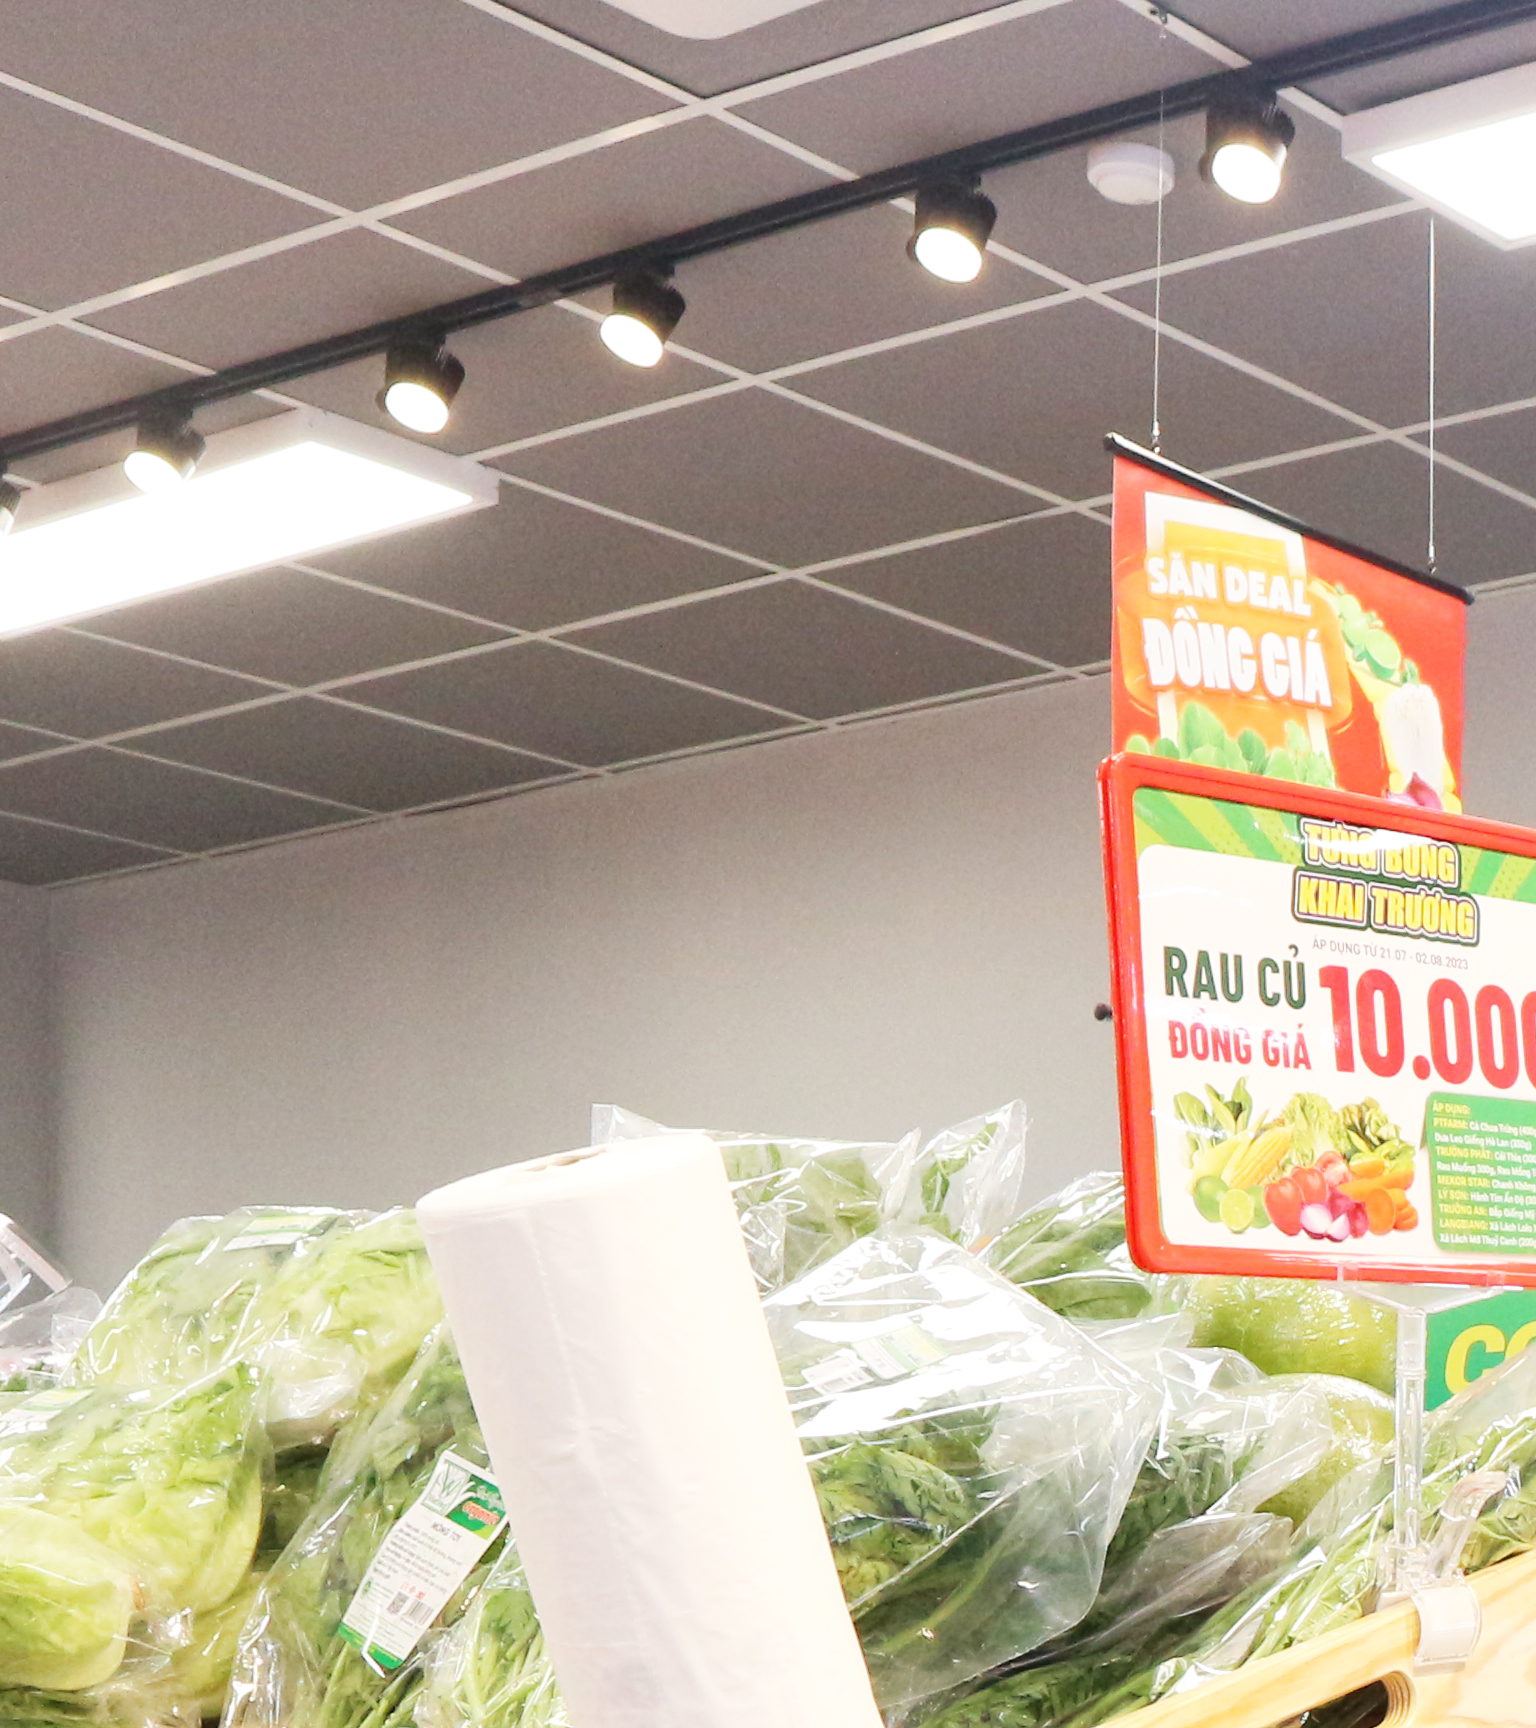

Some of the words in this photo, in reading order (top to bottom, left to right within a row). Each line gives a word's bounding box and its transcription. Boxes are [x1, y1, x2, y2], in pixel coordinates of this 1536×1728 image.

[1148, 548, 1215, 600] SĂN
[1222, 565, 1312, 619] DEAL
[1143, 606, 1258, 692] ĐỒNG
[1262, 627, 1335, 709] GIÁ
[1298, 874, 1366, 922] KHAI
[1370, 886, 1476, 940] TRƯƠNG
[1163, 945, 1245, 1002] RAU
[1257, 942, 1307, 1011] CỦ
[1312, 934, 1327, 949] ÁP
[1330, 940, 1361, 957] DỤNG
[1363, 941, 1379, 957] TỪ
[1380, 947, 1407, 960] 21.07
[1416, 952, 1469, 970] 02.08.2023
[1168, 1008, 1251, 1064] ĐỒNG
[1260, 1018, 1312, 1072] GIÁ
